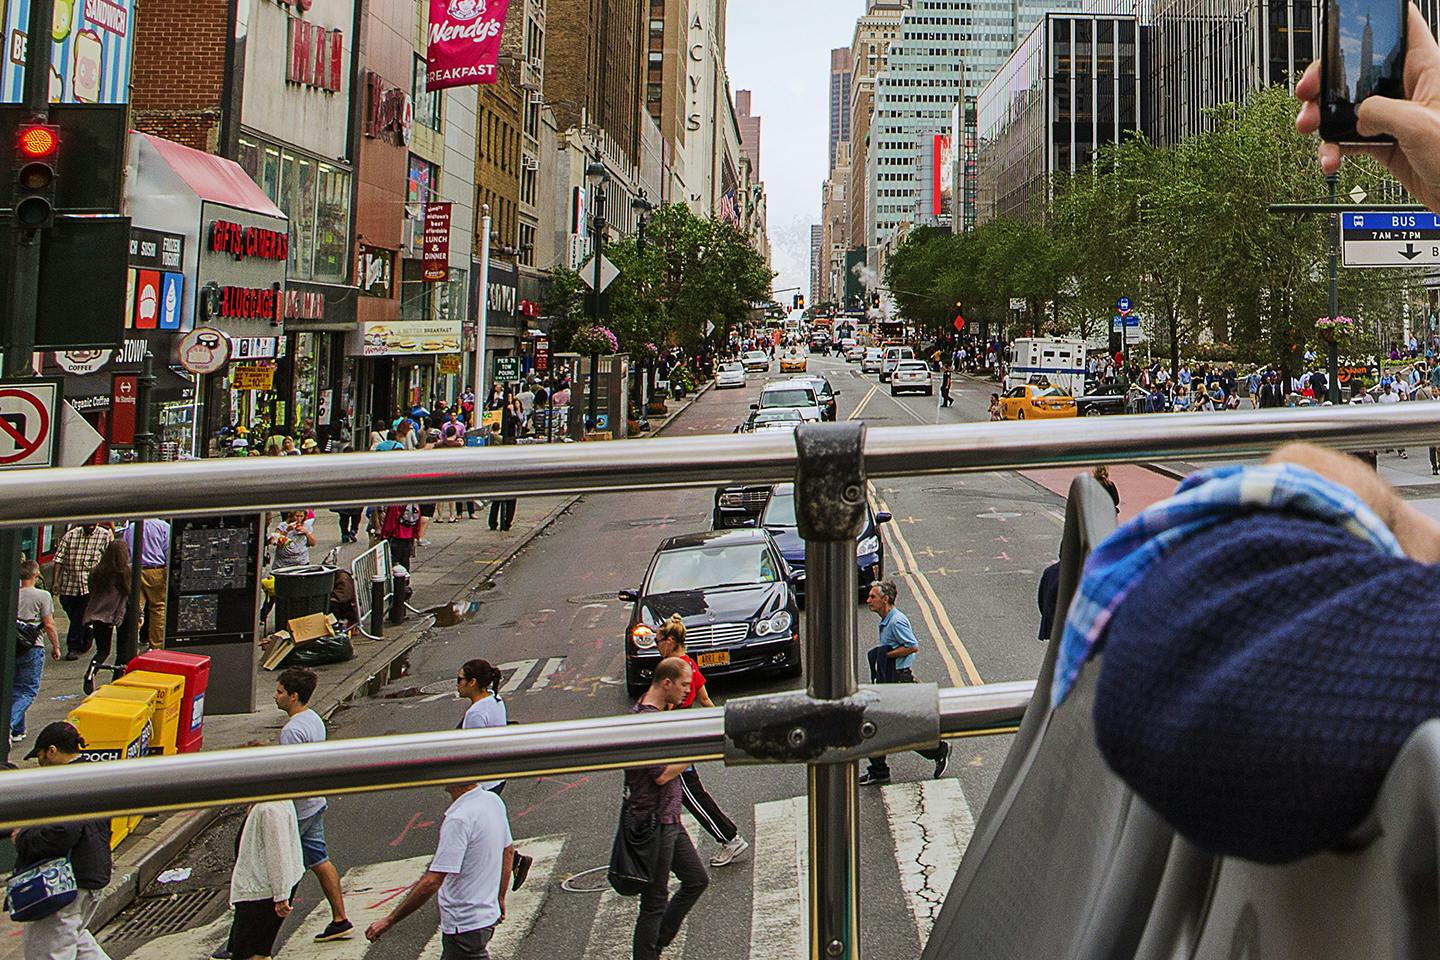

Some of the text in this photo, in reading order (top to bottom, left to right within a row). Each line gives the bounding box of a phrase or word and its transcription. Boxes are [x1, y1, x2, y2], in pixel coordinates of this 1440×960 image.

[427, 16, 501, 47] Wendy's
[287, 16, 343, 92] MAN
[1392, 216, 1416, 227] BUS
[245, 227, 288, 260] CAMERAS
[1378, 232, 1391, 240] AM
[140, 241, 156, 257] SUSHI
[431, 244, 440, 252] &
[229, 287, 273, 320] LUGGAGE
[115, 339, 148, 363] STOWN
[365, 344, 388, 355] Wendy's
[72, 396, 110, 411] Organic Coffee
[80, 752, 119, 762] POCH
